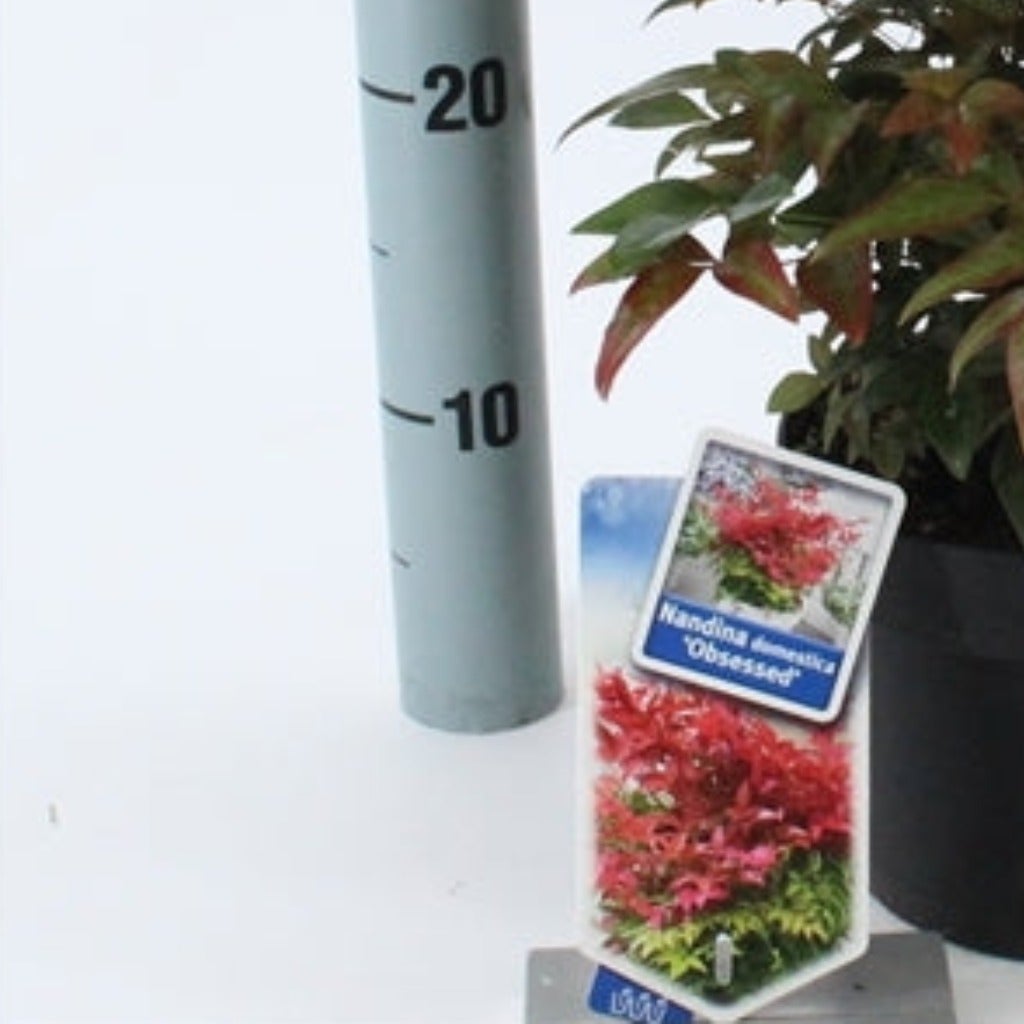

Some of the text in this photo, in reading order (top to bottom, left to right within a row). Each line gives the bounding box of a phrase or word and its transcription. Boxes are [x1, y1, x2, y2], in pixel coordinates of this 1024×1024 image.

[423, 56, 509, 132] 20
[442, 380, 519, 451] 10
[658, 601, 749, 648] Nandina
